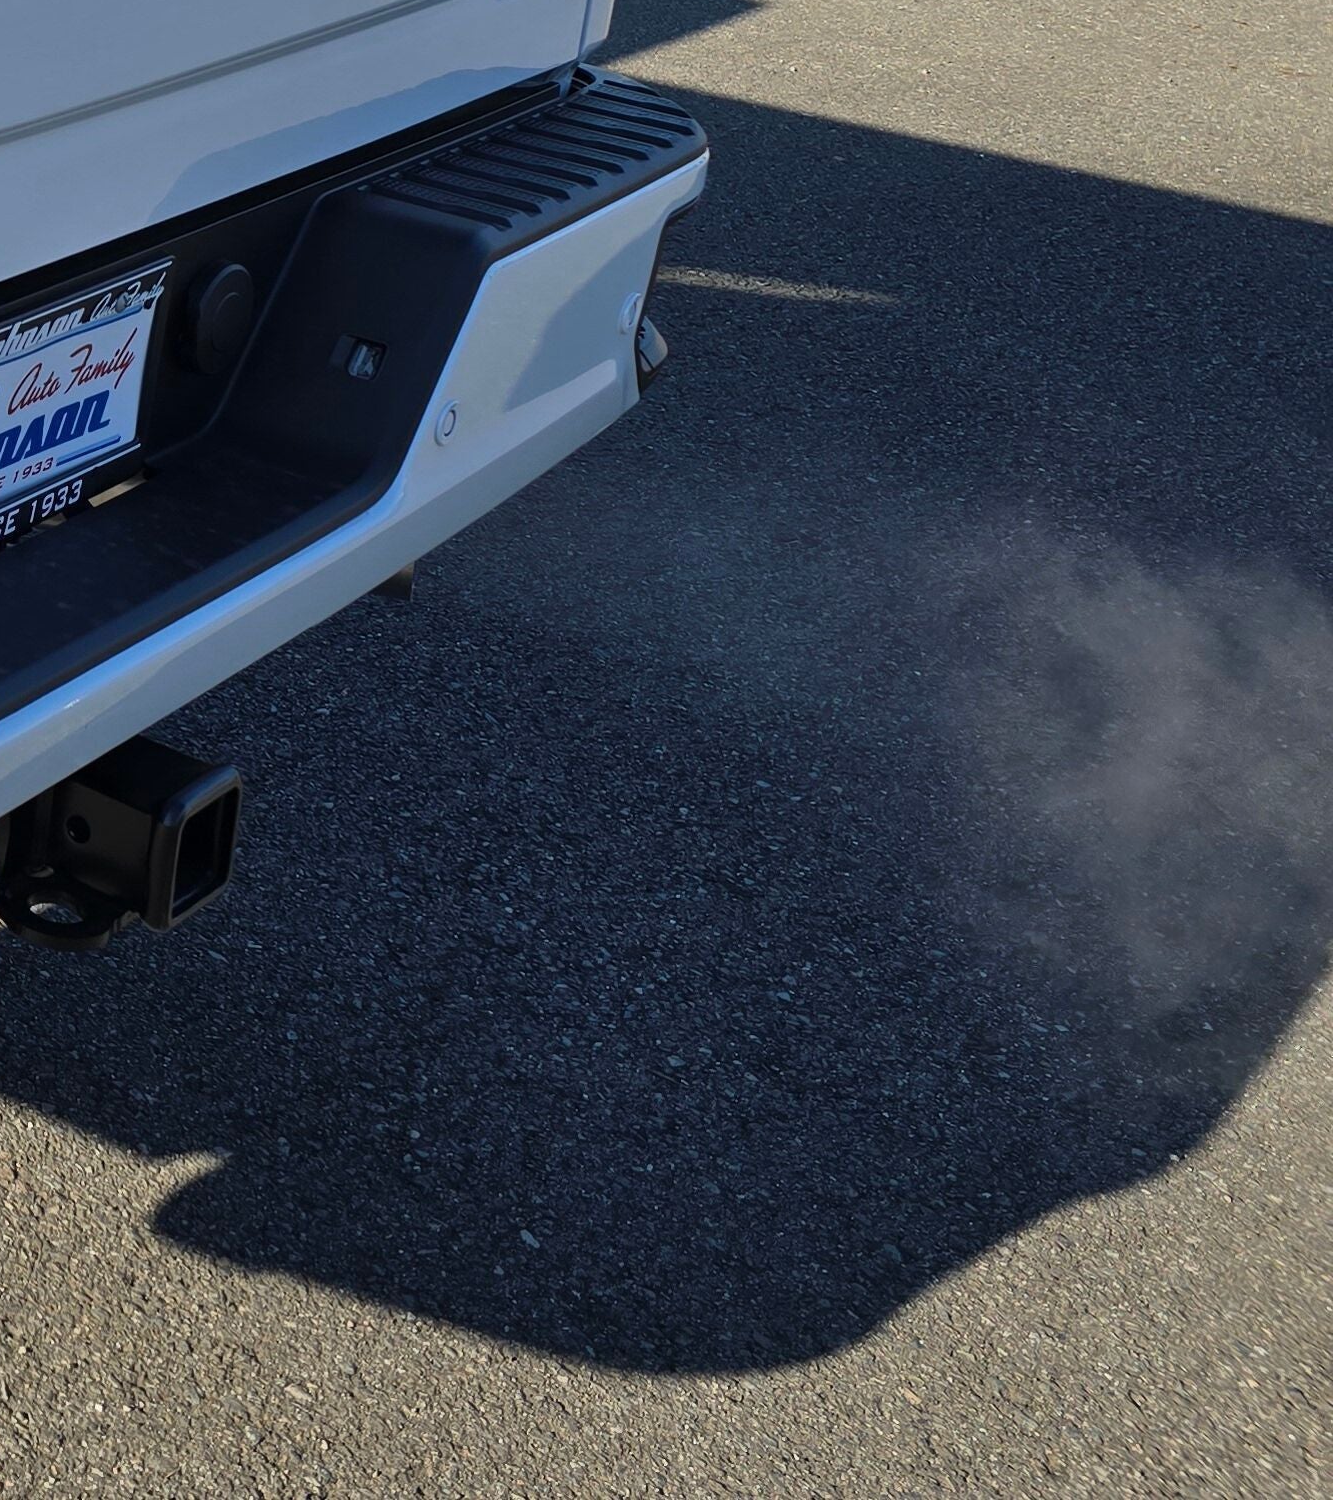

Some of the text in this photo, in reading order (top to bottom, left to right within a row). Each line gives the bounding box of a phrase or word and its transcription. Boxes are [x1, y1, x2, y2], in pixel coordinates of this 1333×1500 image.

[7, 327, 138, 415] Auto Family
[13, 456, 54, 485] 1933
[29, 478, 83, 524] 1933
